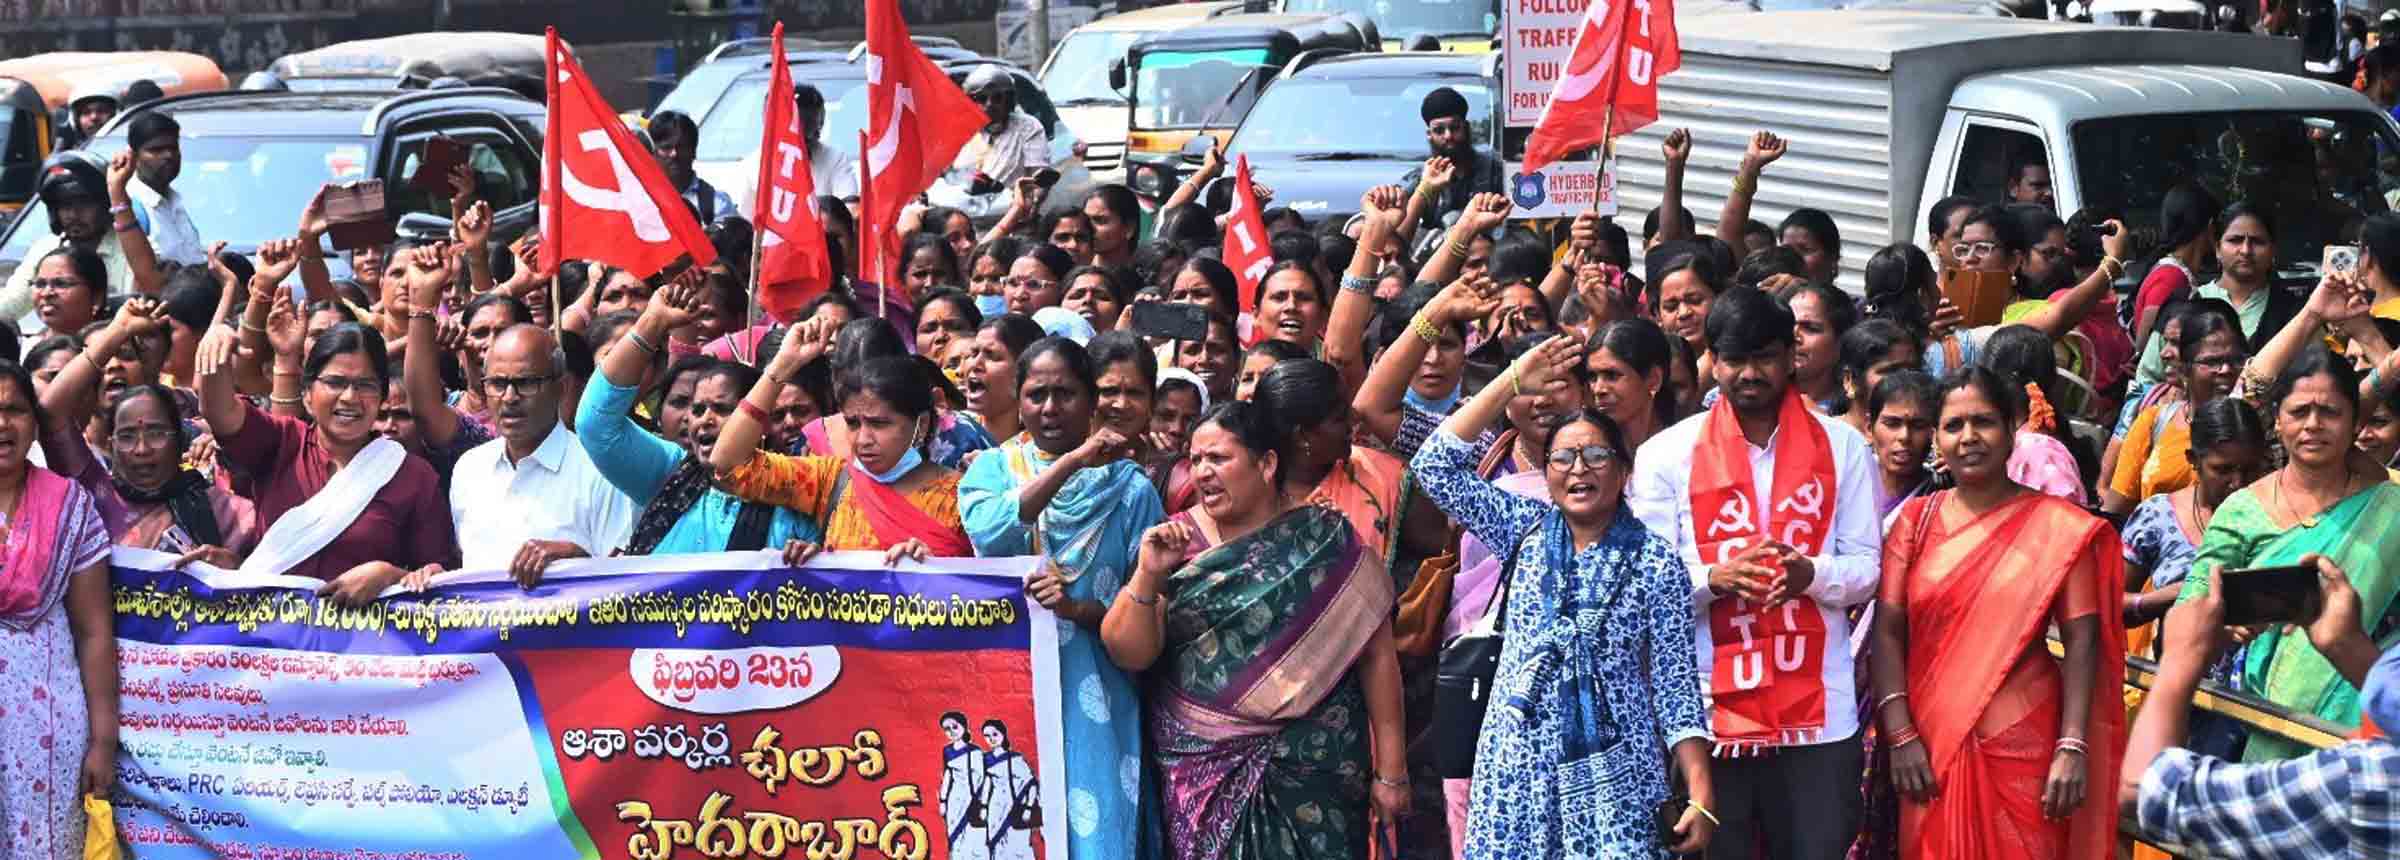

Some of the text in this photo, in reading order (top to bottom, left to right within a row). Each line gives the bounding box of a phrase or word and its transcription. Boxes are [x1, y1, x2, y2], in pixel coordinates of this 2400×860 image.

[1518, 27, 1577, 48] TRAFF
[1513, 92, 1537, 108] FOR
[588, 591, 627, 624] ఇతర
[631, 590, 696, 638] సమస్యల
[698, 586, 774, 634] పరిష్కారం
[776, 581, 824, 622] కోసం
[827, 588, 890, 623] సరిపడా
[894, 592, 947, 632] నిధులు
[950, 594, 1016, 627] పెంచాలి
[1716, 537, 1764, 690] CTU
[1774, 520, 1812, 672] CTU
[747, 652, 813, 688] 23న
[562, 723, 732, 769] ఆశా వర్కర్ల
[188, 773, 225, 796] PRC
